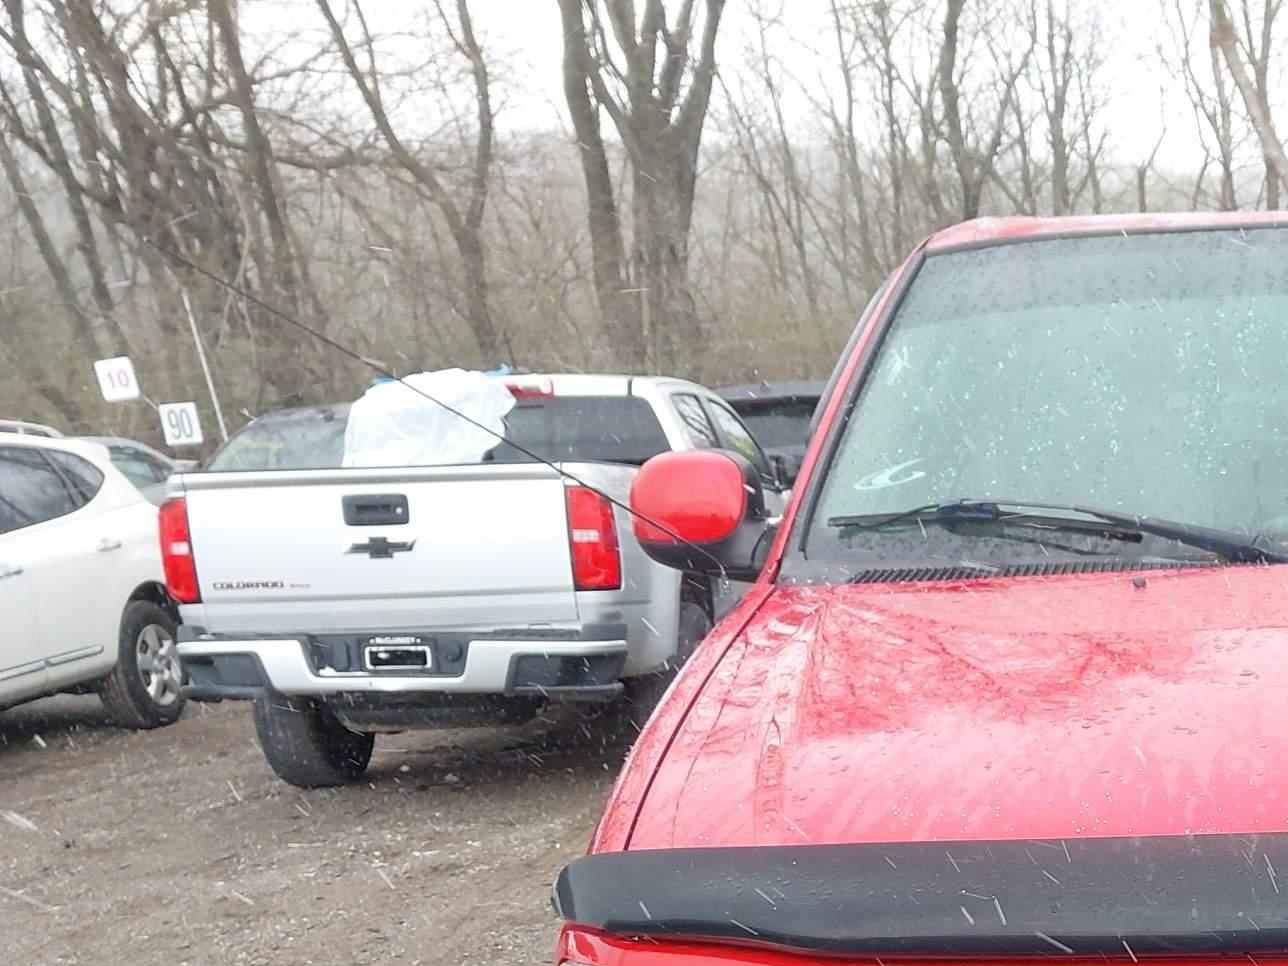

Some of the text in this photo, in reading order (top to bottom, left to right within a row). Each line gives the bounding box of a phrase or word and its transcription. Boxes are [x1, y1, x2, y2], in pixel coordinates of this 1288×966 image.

[107, 369, 130, 389] 10
[167, 407, 194, 440] 90
[212, 580, 285, 591] COLORADO
